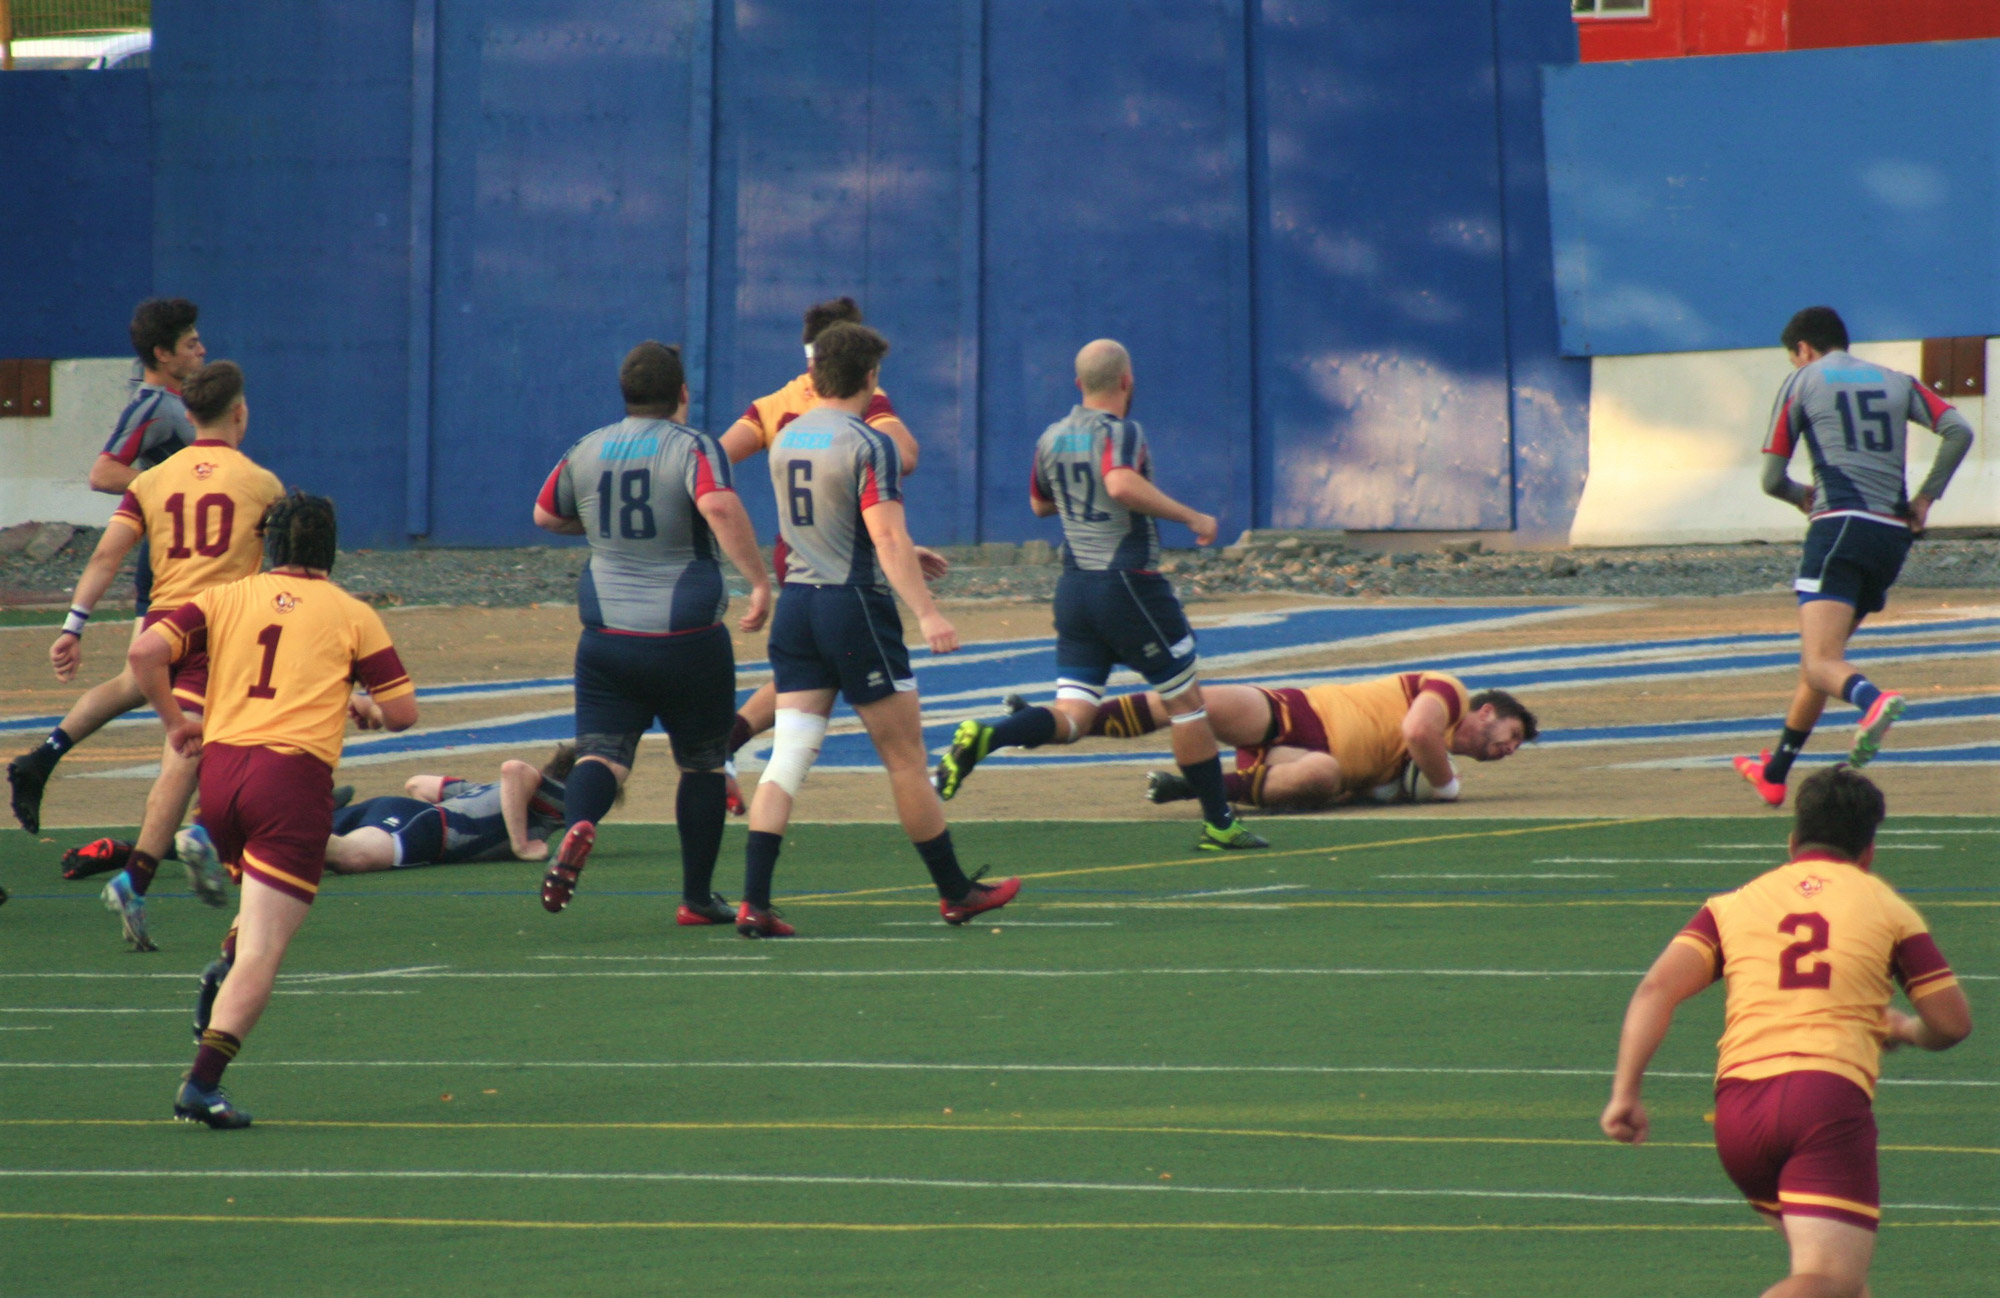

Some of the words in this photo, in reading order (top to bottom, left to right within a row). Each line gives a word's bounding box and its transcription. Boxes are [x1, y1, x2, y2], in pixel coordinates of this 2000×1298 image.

[1835, 390, 1893, 452] 15
[597, 468, 657, 540] 18
[788, 459, 814, 526] 6
[1053, 461, 1111, 522] 12
[164, 492, 235, 559] 10
[248, 624, 283, 699] 1
[1777, 912, 1832, 990] 2
